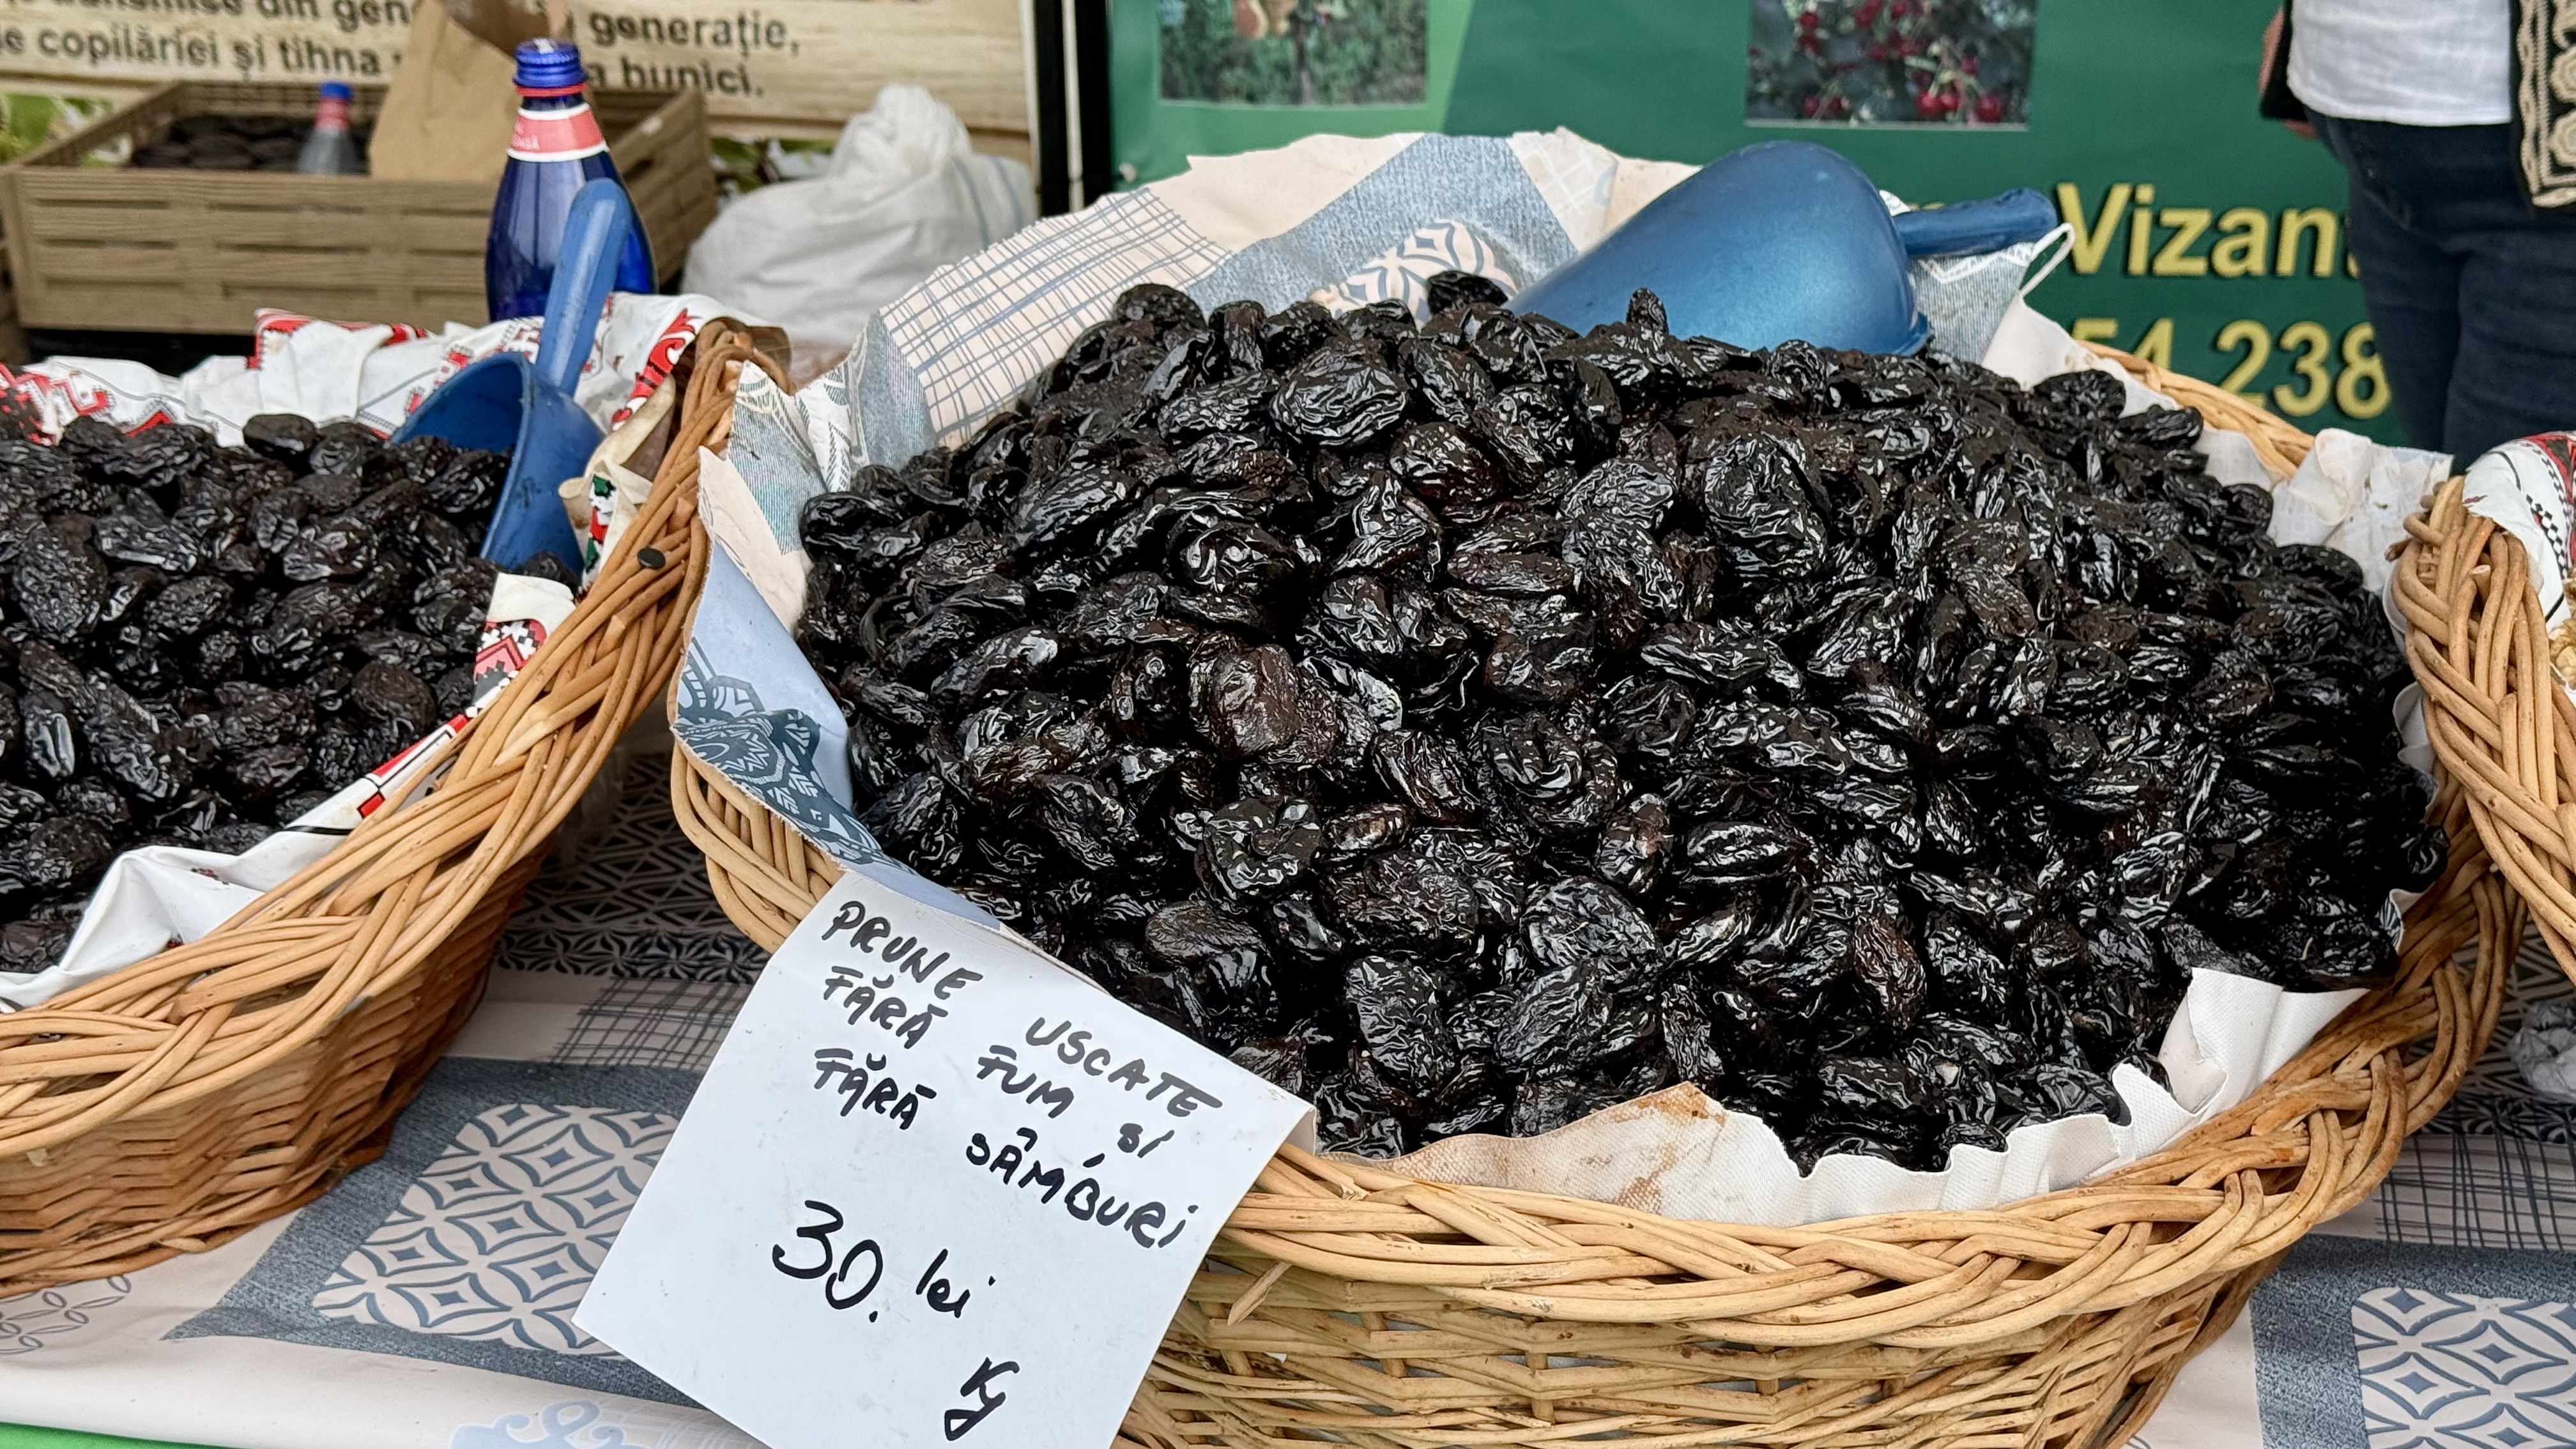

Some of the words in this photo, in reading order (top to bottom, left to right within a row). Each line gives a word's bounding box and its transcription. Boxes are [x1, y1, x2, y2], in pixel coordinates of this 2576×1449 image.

[333, 0, 411, 32] gen
[0, 28, 25, 56] e
[37, 22, 220, 68] copilăriei
[279, 36, 381, 77] tihna
[620, 56, 765, 97] bunici.
[2054, 182, 2360, 279] Vizan
[820, 900, 984, 1001] PRUNE
[1025, 1016, 1223, 1118] USCATE
[976, 1044, 1075, 1119] FUM
[915, 1248, 997, 1319] lei
